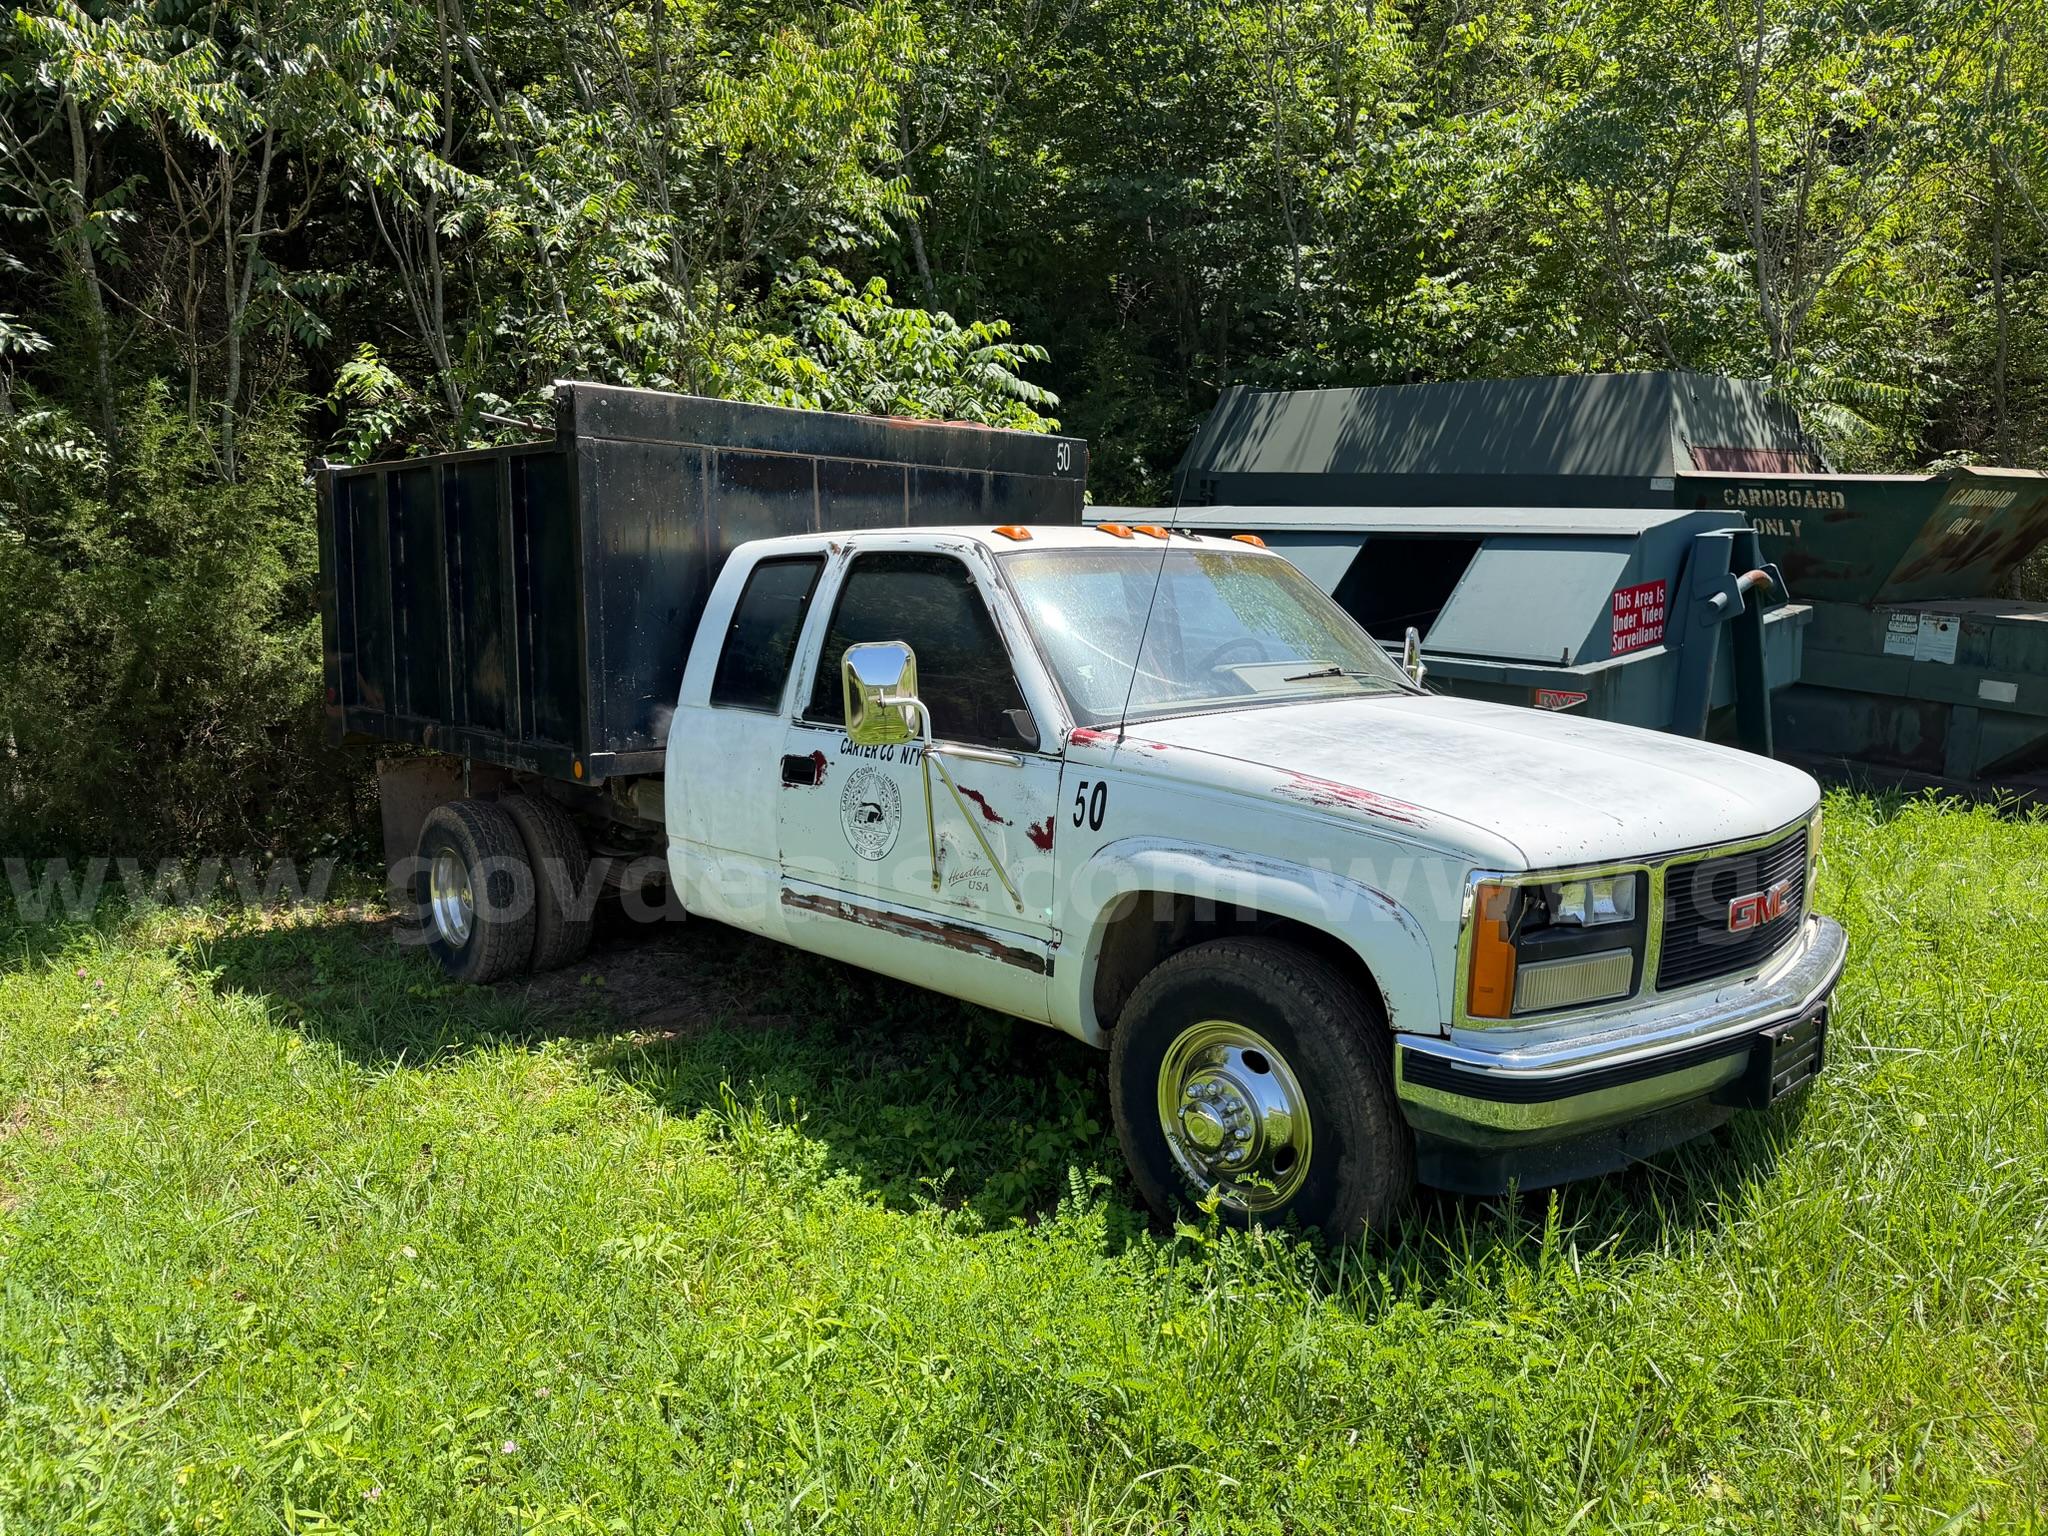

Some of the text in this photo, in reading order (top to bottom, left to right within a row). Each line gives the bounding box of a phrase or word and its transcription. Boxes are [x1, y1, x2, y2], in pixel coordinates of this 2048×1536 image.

[1057, 442, 1071, 471] 50
[1723, 488, 1845, 509] CARDBOARD
[1949, 488, 2018, 508] CARDBOARD
[1752, 518, 1802, 536] ONLY
[1946, 517, 1981, 536] ONLY
[1614, 586, 1665, 611] This Area Is
[1613, 606, 1664, 633] Under Video
[1891, 613, 1917, 622] CAUTION
[1612, 625, 1663, 652] Surveillance
[840, 738, 878, 760] CARTER
[1073, 781, 1107, 831] 50
[968, 881, 989, 892] USA
[1729, 880, 1791, 932] GMC
